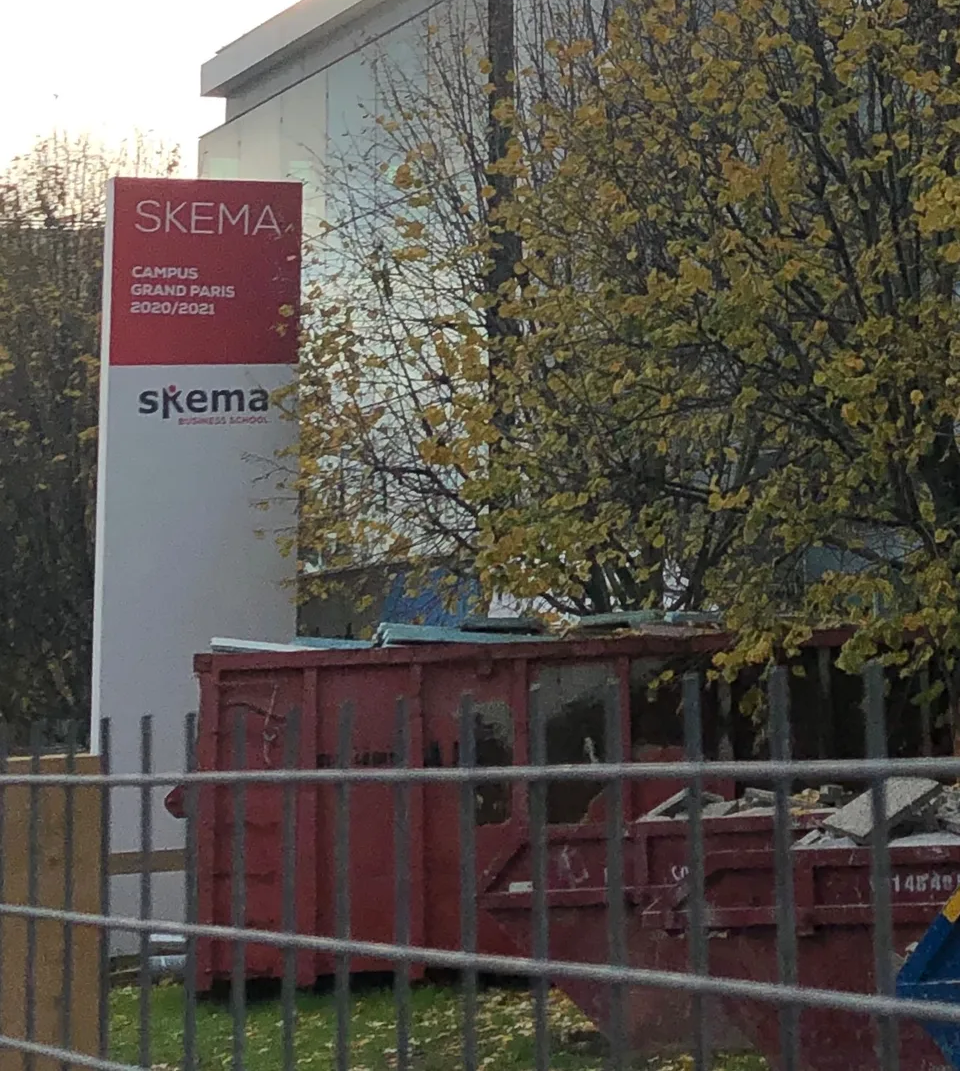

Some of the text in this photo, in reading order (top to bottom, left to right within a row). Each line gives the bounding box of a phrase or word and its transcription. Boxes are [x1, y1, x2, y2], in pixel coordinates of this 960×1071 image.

[134, 199, 282, 236] SKEMA
[131, 265, 199, 280] CAMPUS
[130, 283, 236, 298] GRAND PARIS
[129, 301, 216, 316] 2020/2021
[138, 384, 269, 419] skema
[178, 415, 271, 426] BUSINESS SCHOOL
